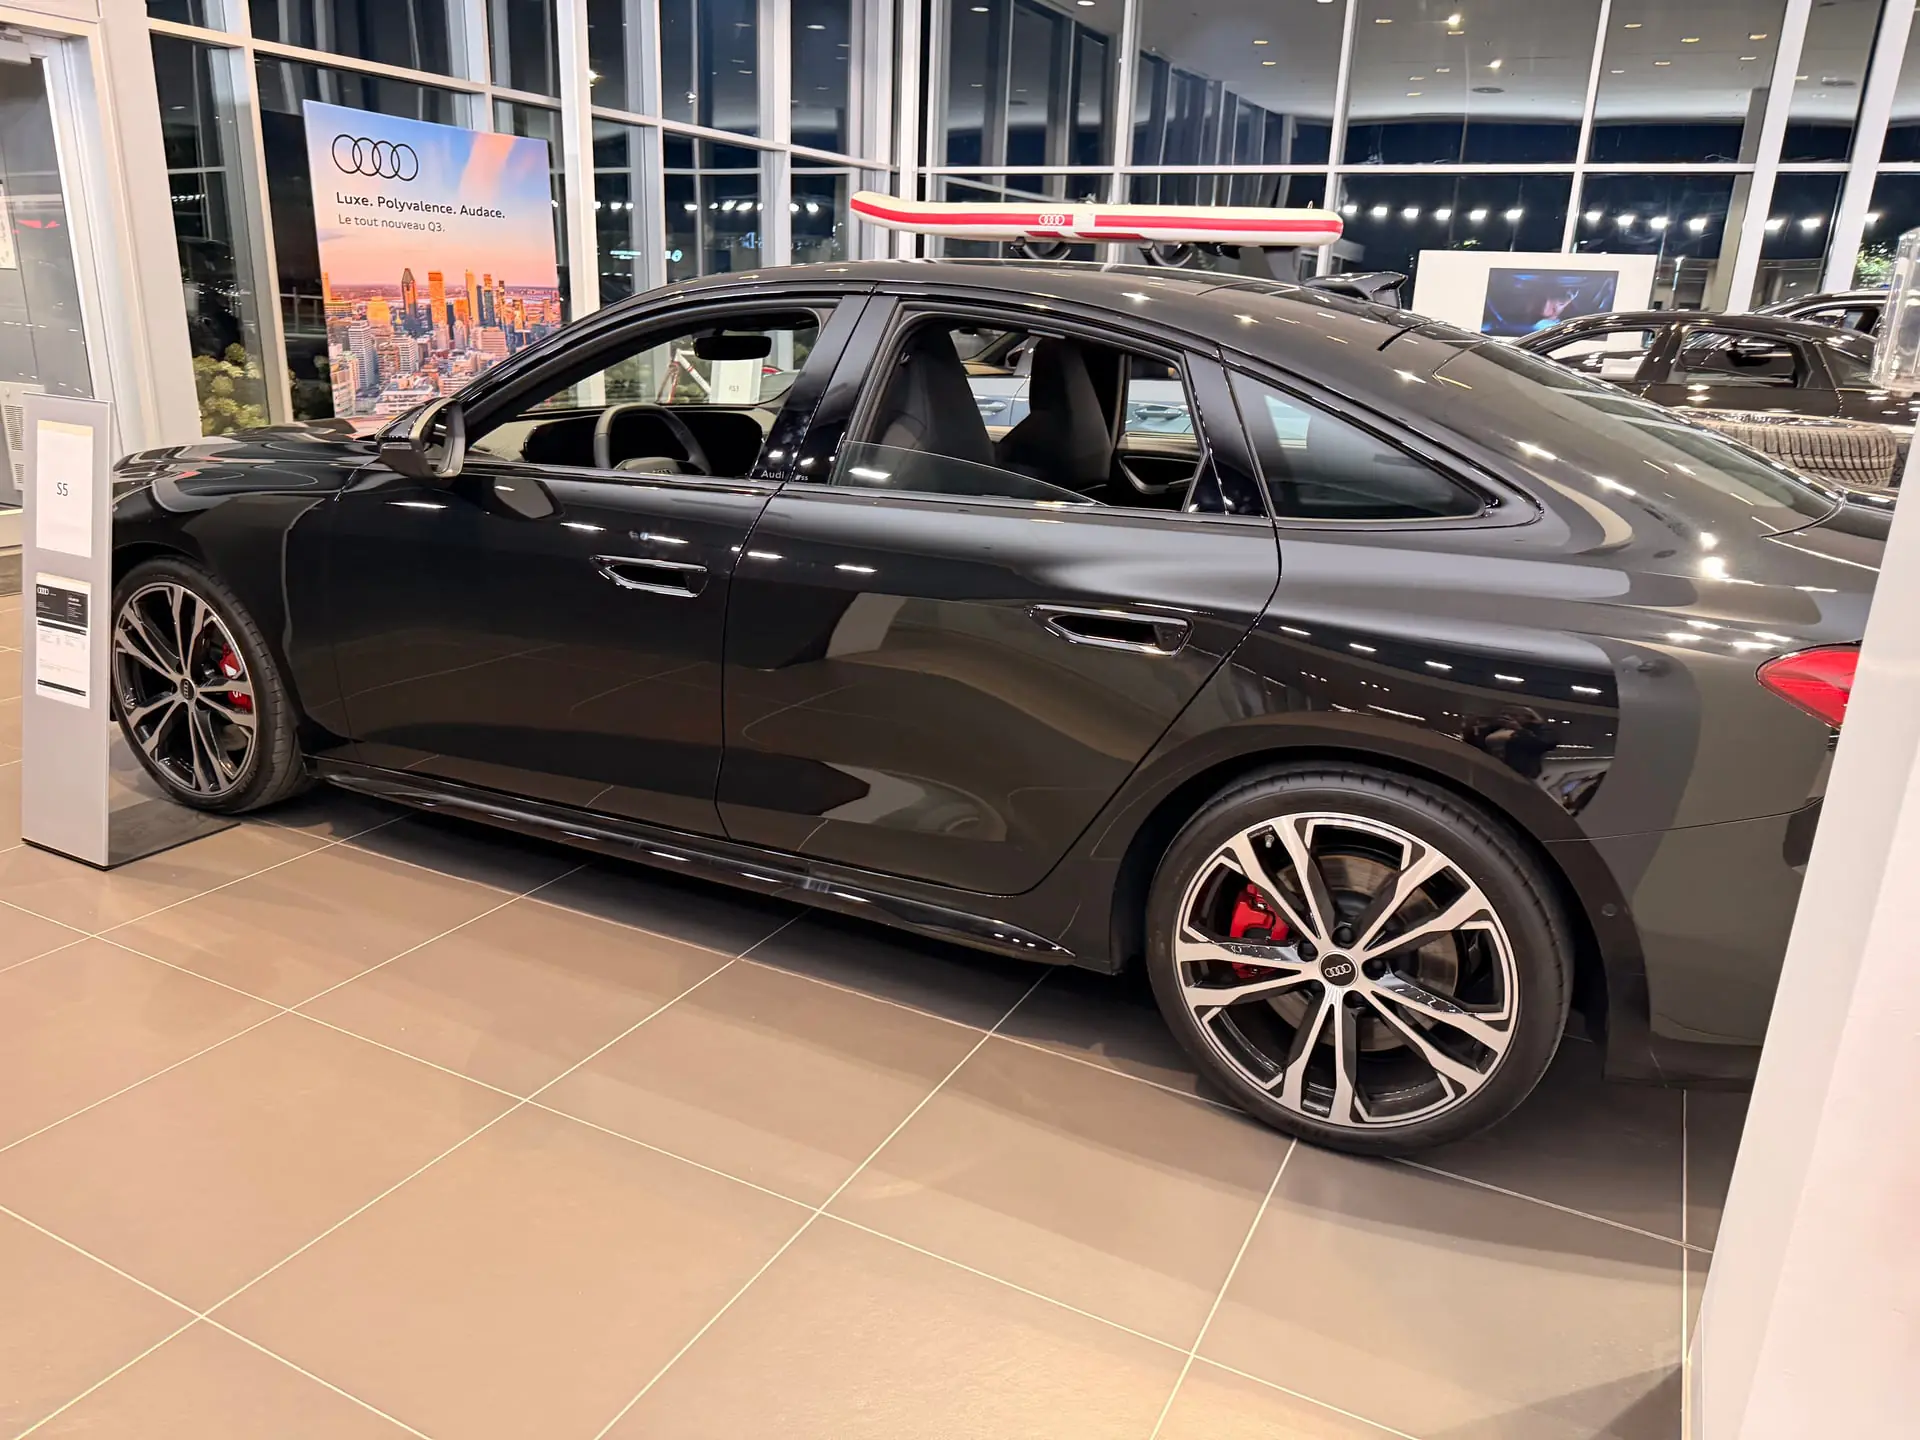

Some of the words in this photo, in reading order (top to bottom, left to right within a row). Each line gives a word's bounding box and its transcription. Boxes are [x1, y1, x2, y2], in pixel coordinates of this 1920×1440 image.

[336, 191, 373, 206] Luxe.
[377, 196, 457, 214] Polyvalence.
[460, 205, 505, 218] Audace.
[338, 214, 352, 225] Le
[354, 216, 378, 228] tout
[381, 220, 425, 232] nouveau
[428, 222, 446, 232] Q3.
[760, 470, 785, 479] Audi
[56, 482, 69, 497] S5
